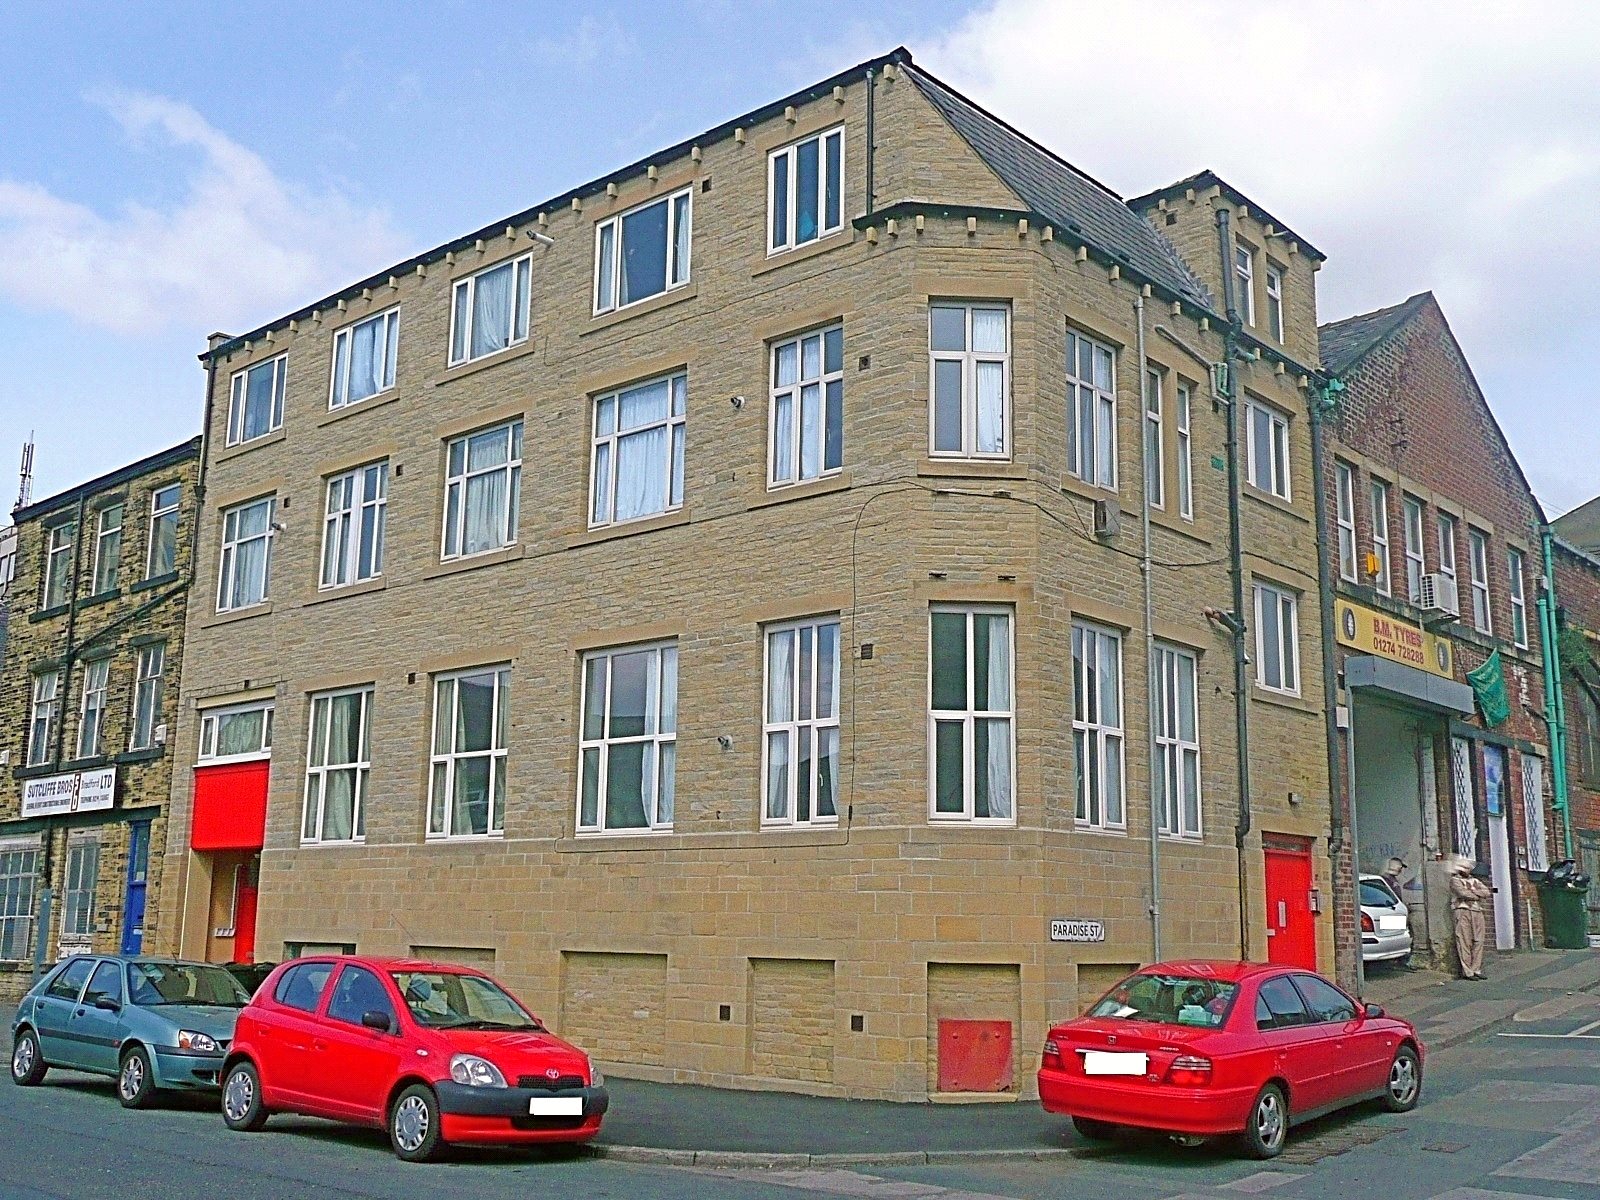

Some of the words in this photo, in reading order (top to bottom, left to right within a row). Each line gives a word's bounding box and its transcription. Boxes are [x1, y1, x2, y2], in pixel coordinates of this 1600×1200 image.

[1373, 618, 1392, 639] B.M.
[1394, 625, 1422, 647] TYRES
[1373, 637, 1396, 656] 01274
[27, 781, 57, 798] SUTCLIFFE
[57, 780, 73, 795] BROS
[100, 774, 112, 789] LTD
[1053, 924, 1089, 937] PARADISE
[1090, 925, 1099, 937] ST
